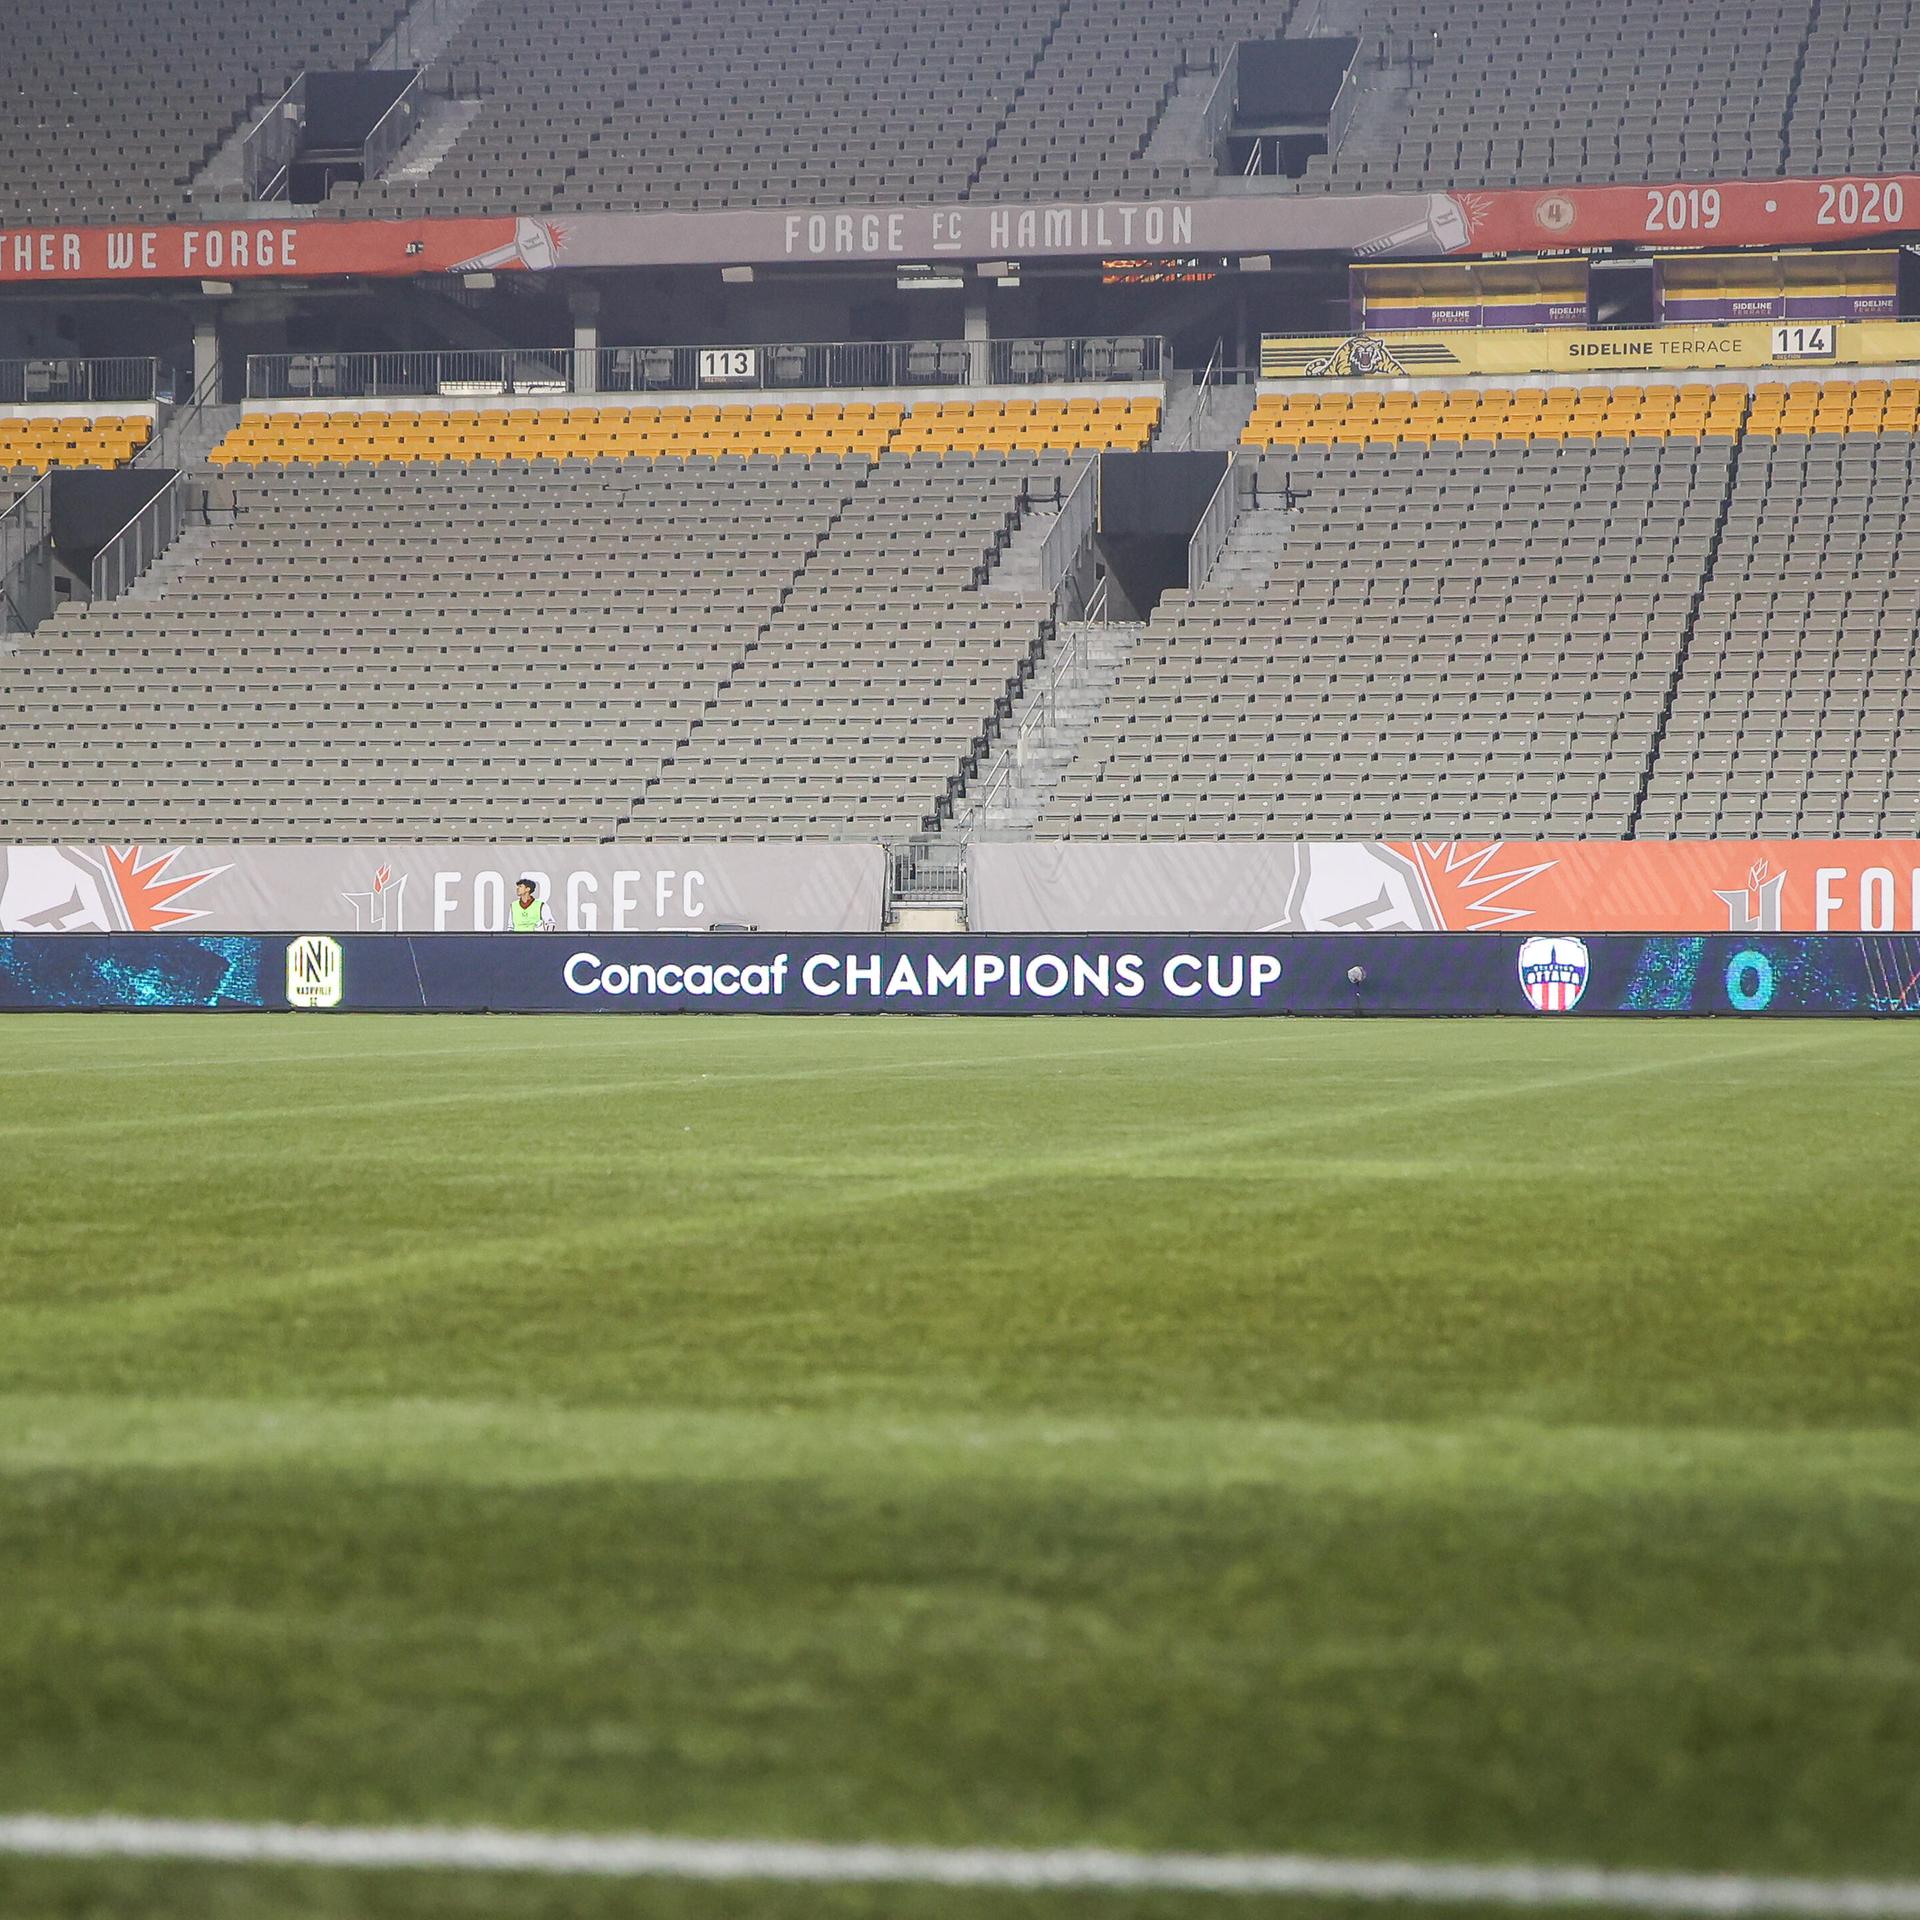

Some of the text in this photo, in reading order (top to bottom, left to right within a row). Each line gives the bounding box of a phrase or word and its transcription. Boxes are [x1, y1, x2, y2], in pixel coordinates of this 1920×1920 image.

[1645, 182, 1904, 231] 2019 2020
[785, 206, 1193, 254] FORGE FC HAMILTON
[107, 232, 157, 270] WE
[183, 229, 297, 268] FORGE
[1432, 310, 1470, 318] SIDELINE
[1549, 307, 1587, 315] SIDELINE
[1732, 302, 1772, 310] SIDELINE
[1854, 299, 1893, 307] SIDELINE
[1569, 339, 1742, 356] SIDELINE TERRACE
[1778, 328, 1824, 352] 114
[706, 352, 748, 375] 113
[656, 870, 705, 918] FC
[563, 952, 1282, 997] Concacaf CHAMPIONS CUP
[1527, 969, 1580, 985] OTTAWA
